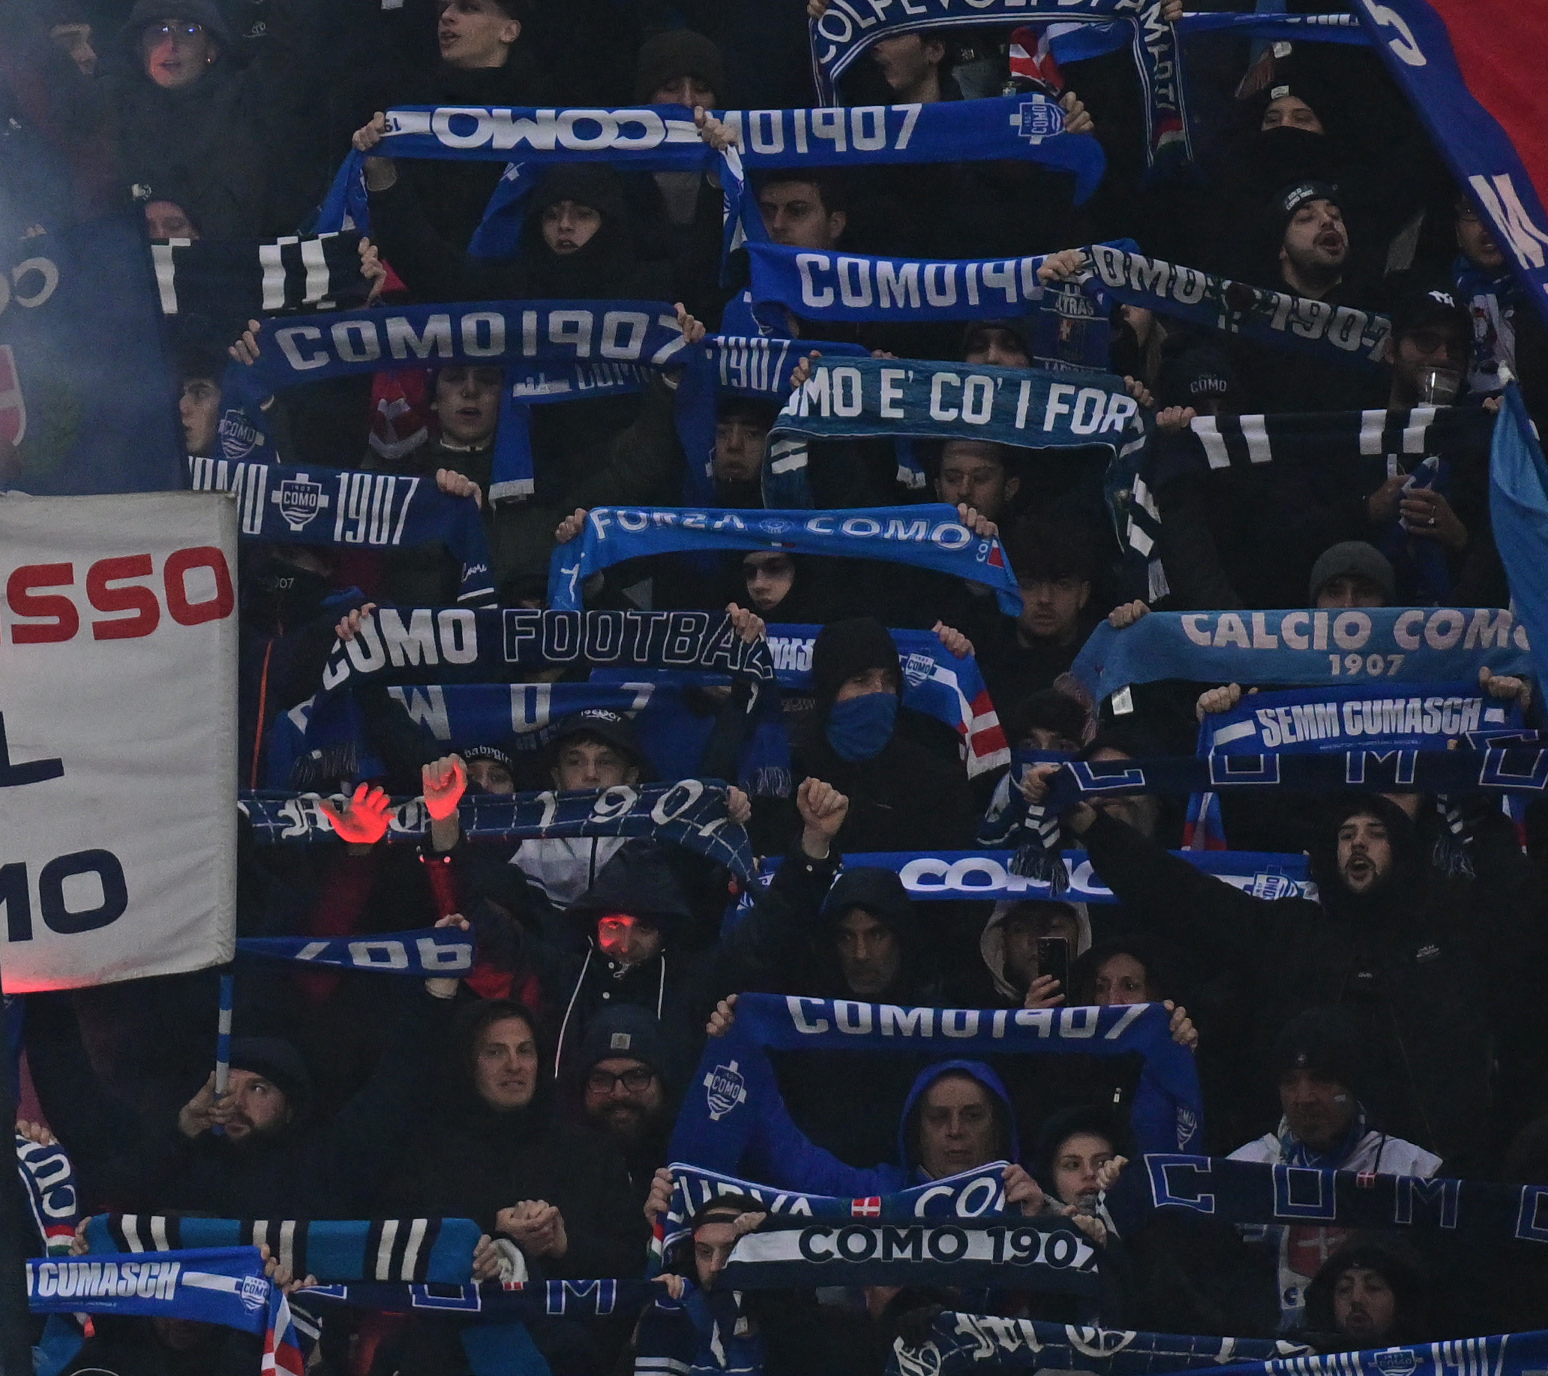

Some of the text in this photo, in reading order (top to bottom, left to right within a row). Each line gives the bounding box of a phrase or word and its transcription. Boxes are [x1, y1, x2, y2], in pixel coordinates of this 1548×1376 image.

[431, 107, 668, 153] COMO
[333, 471, 421, 545] 1907
[1180, 610, 1372, 651] CALCIO
[1328, 653, 1405, 677] 1907
[1256, 700, 1483, 747] SEMM CUMASCH
[799, 1223, 972, 1266] COMO
[37, 1262, 181, 1301] CUMASCH
